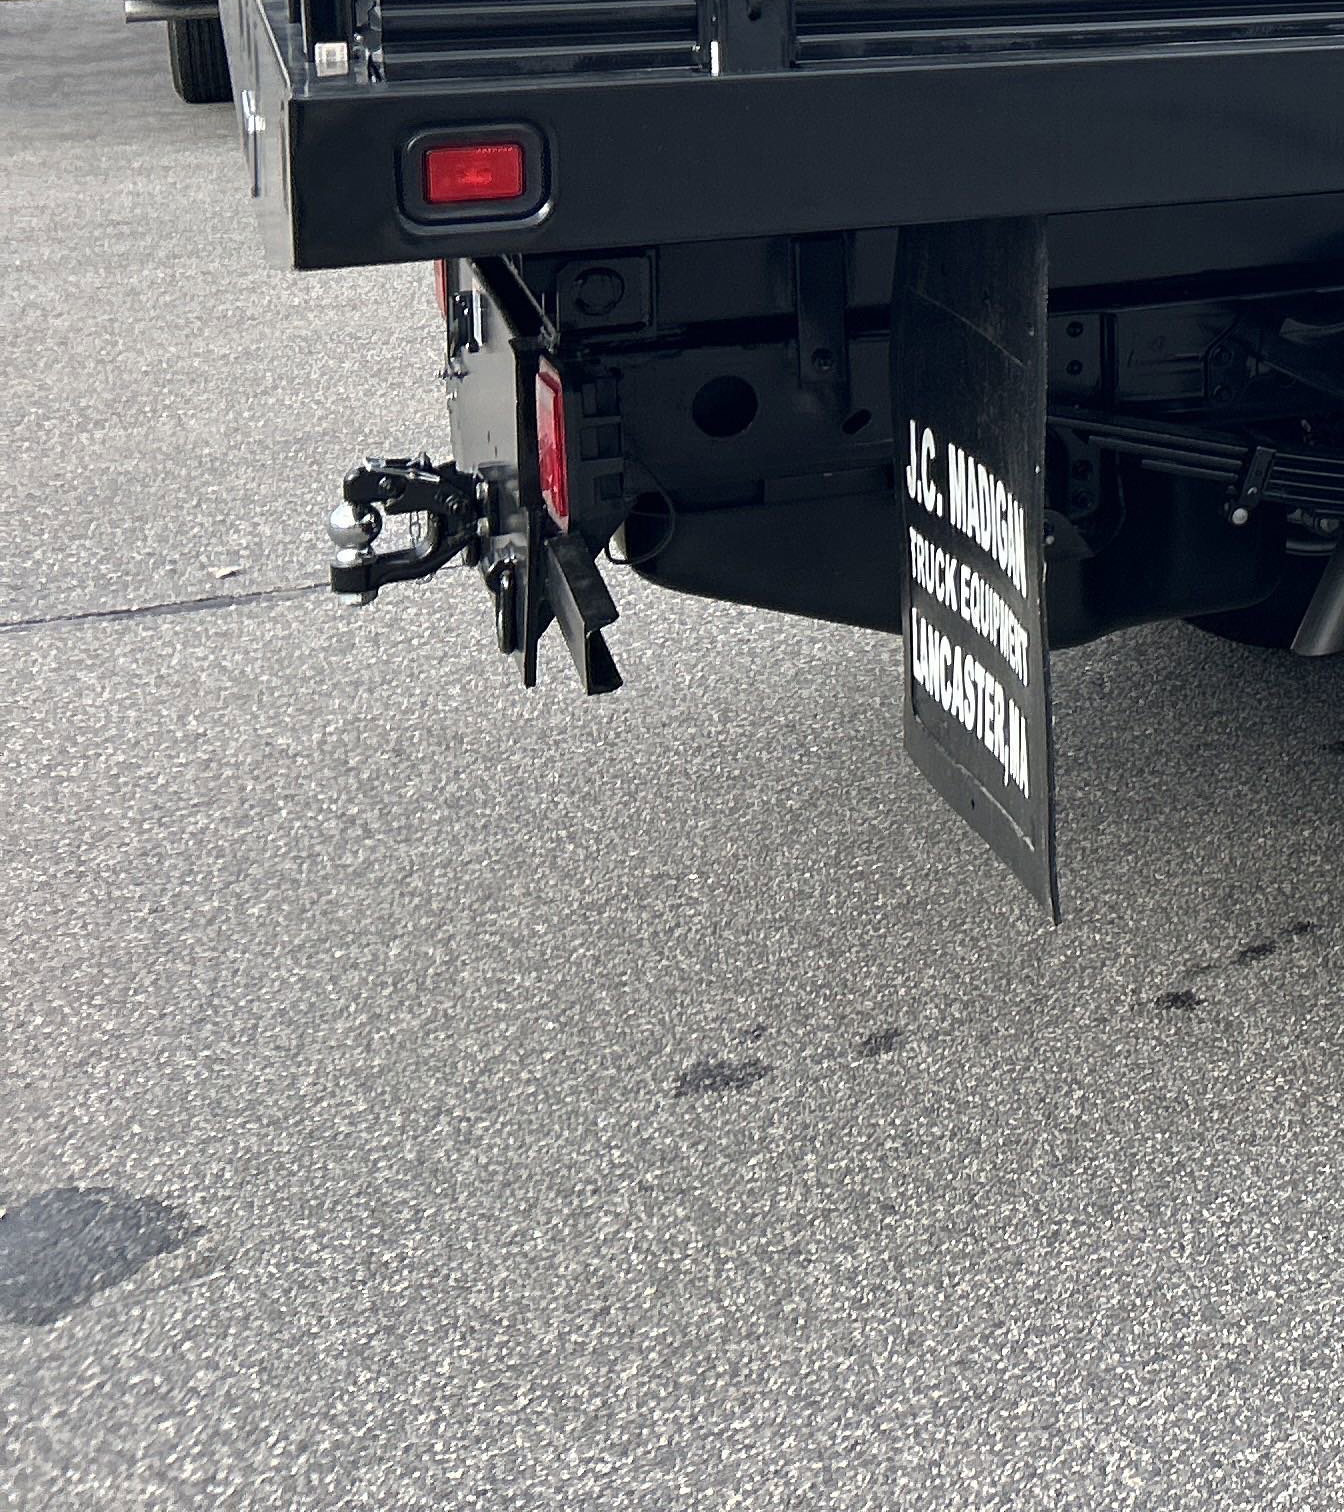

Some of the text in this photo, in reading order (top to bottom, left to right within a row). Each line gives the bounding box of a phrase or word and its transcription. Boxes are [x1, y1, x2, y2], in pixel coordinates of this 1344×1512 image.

[906, 419, 1027, 599] J.C. MADIGAN
[909, 526, 1029, 687] TRUCK EQUIPMENT
